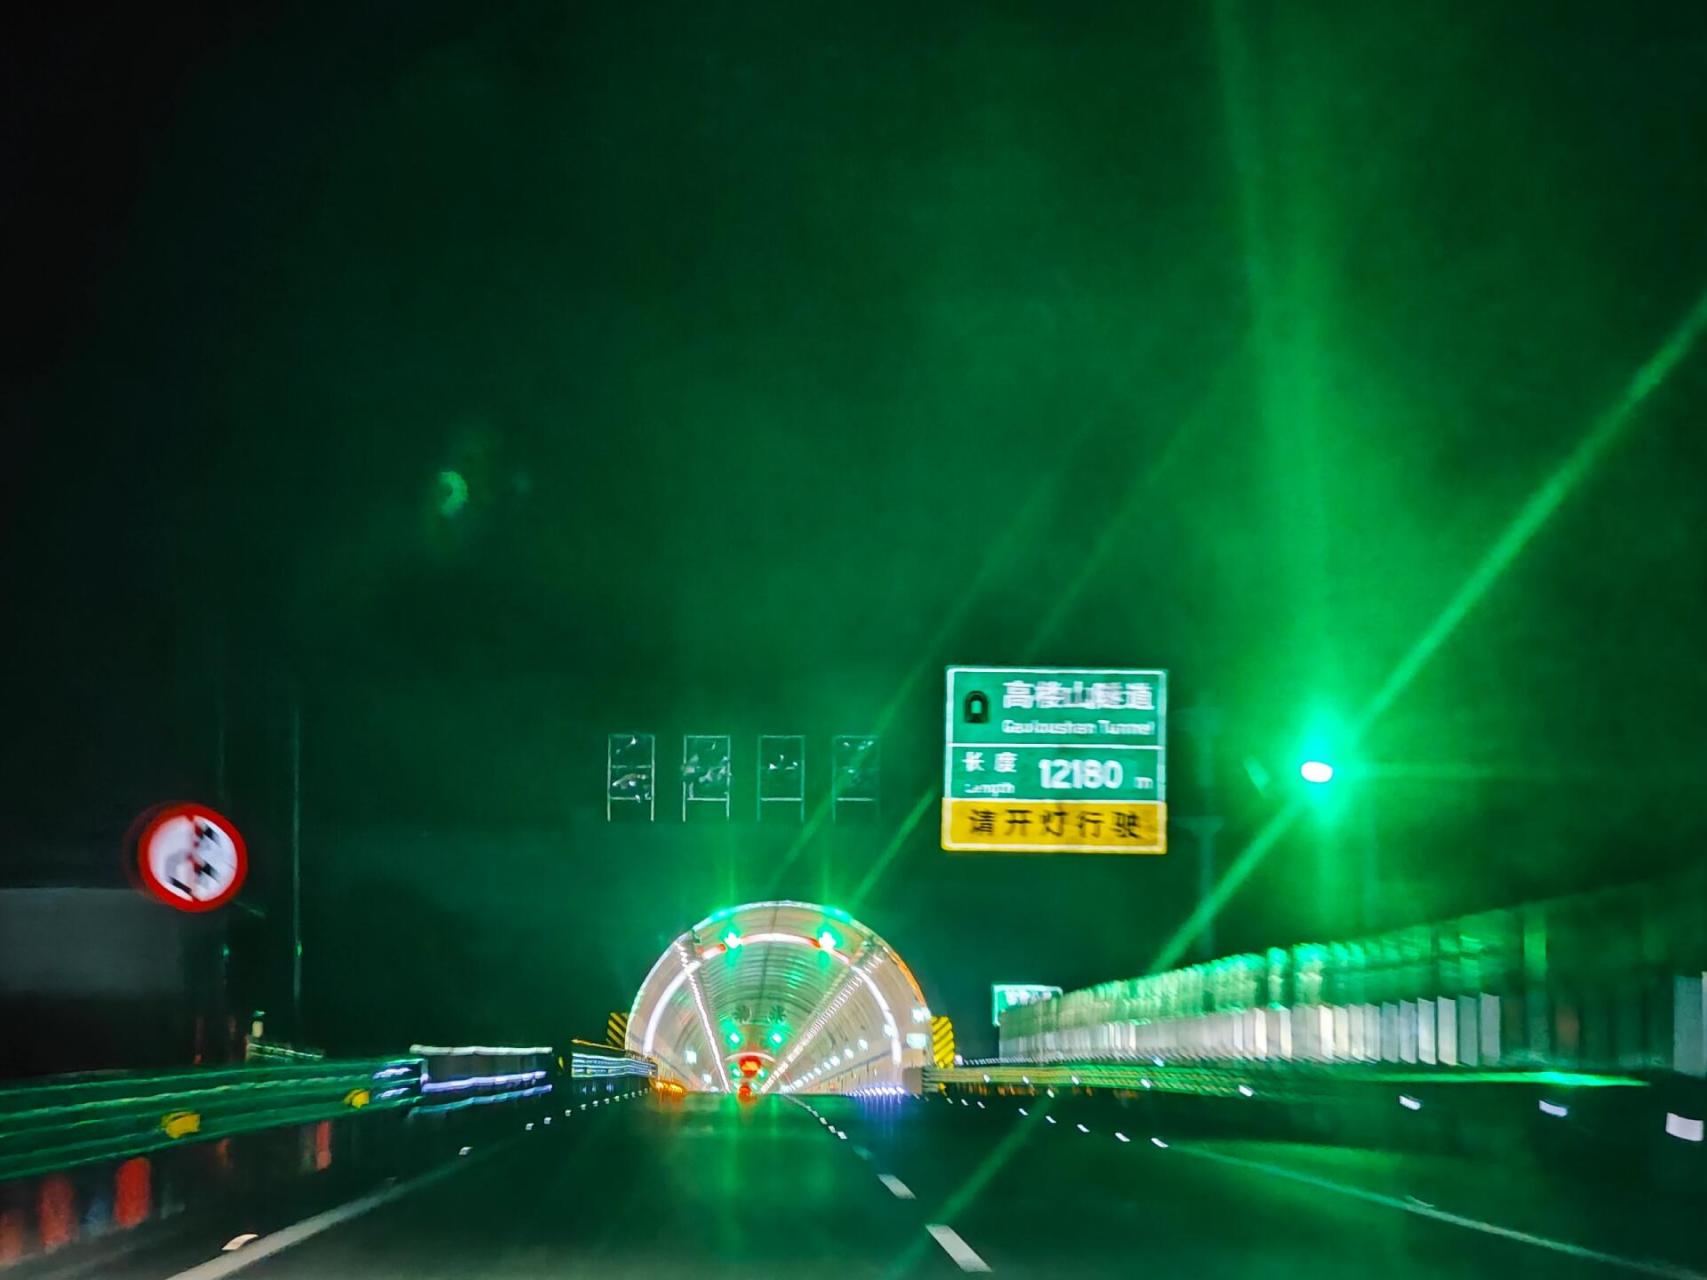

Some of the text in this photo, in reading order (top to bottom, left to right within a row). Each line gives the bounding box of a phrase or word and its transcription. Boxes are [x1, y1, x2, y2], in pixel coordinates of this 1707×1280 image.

[1097, 720, 1155, 735] Tunnel
[963, 752, 1018, 772] 长度
[1038, 759, 1123, 789] 12180
[968, 808, 1141, 839] 请开灯行驶
